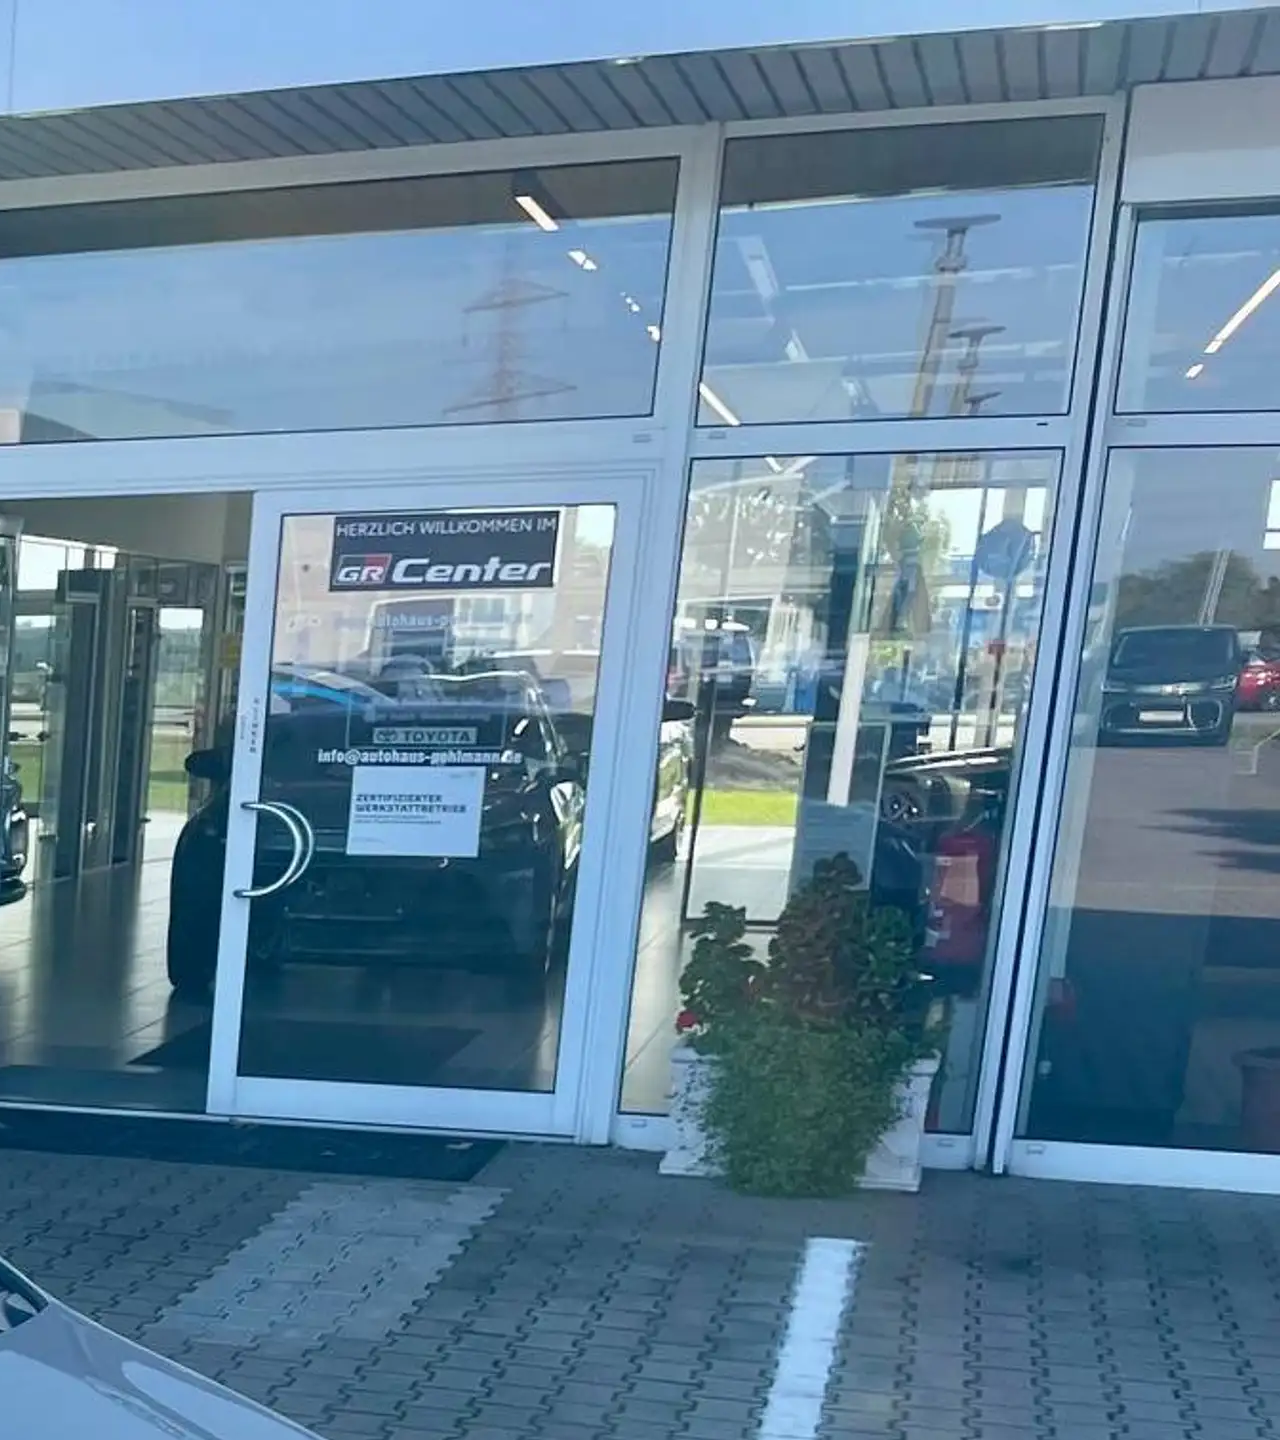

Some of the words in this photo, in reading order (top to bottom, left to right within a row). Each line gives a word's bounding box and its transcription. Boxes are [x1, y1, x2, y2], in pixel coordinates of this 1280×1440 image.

[336, 521, 415, 537] HERZLICH
[419, 518, 532, 535] WILLKOMMEN
[537, 517, 556, 533] IM
[338, 565, 384, 583] GR
[392, 555, 551, 583] Center
[403, 730, 472, 743] TOYOTA
